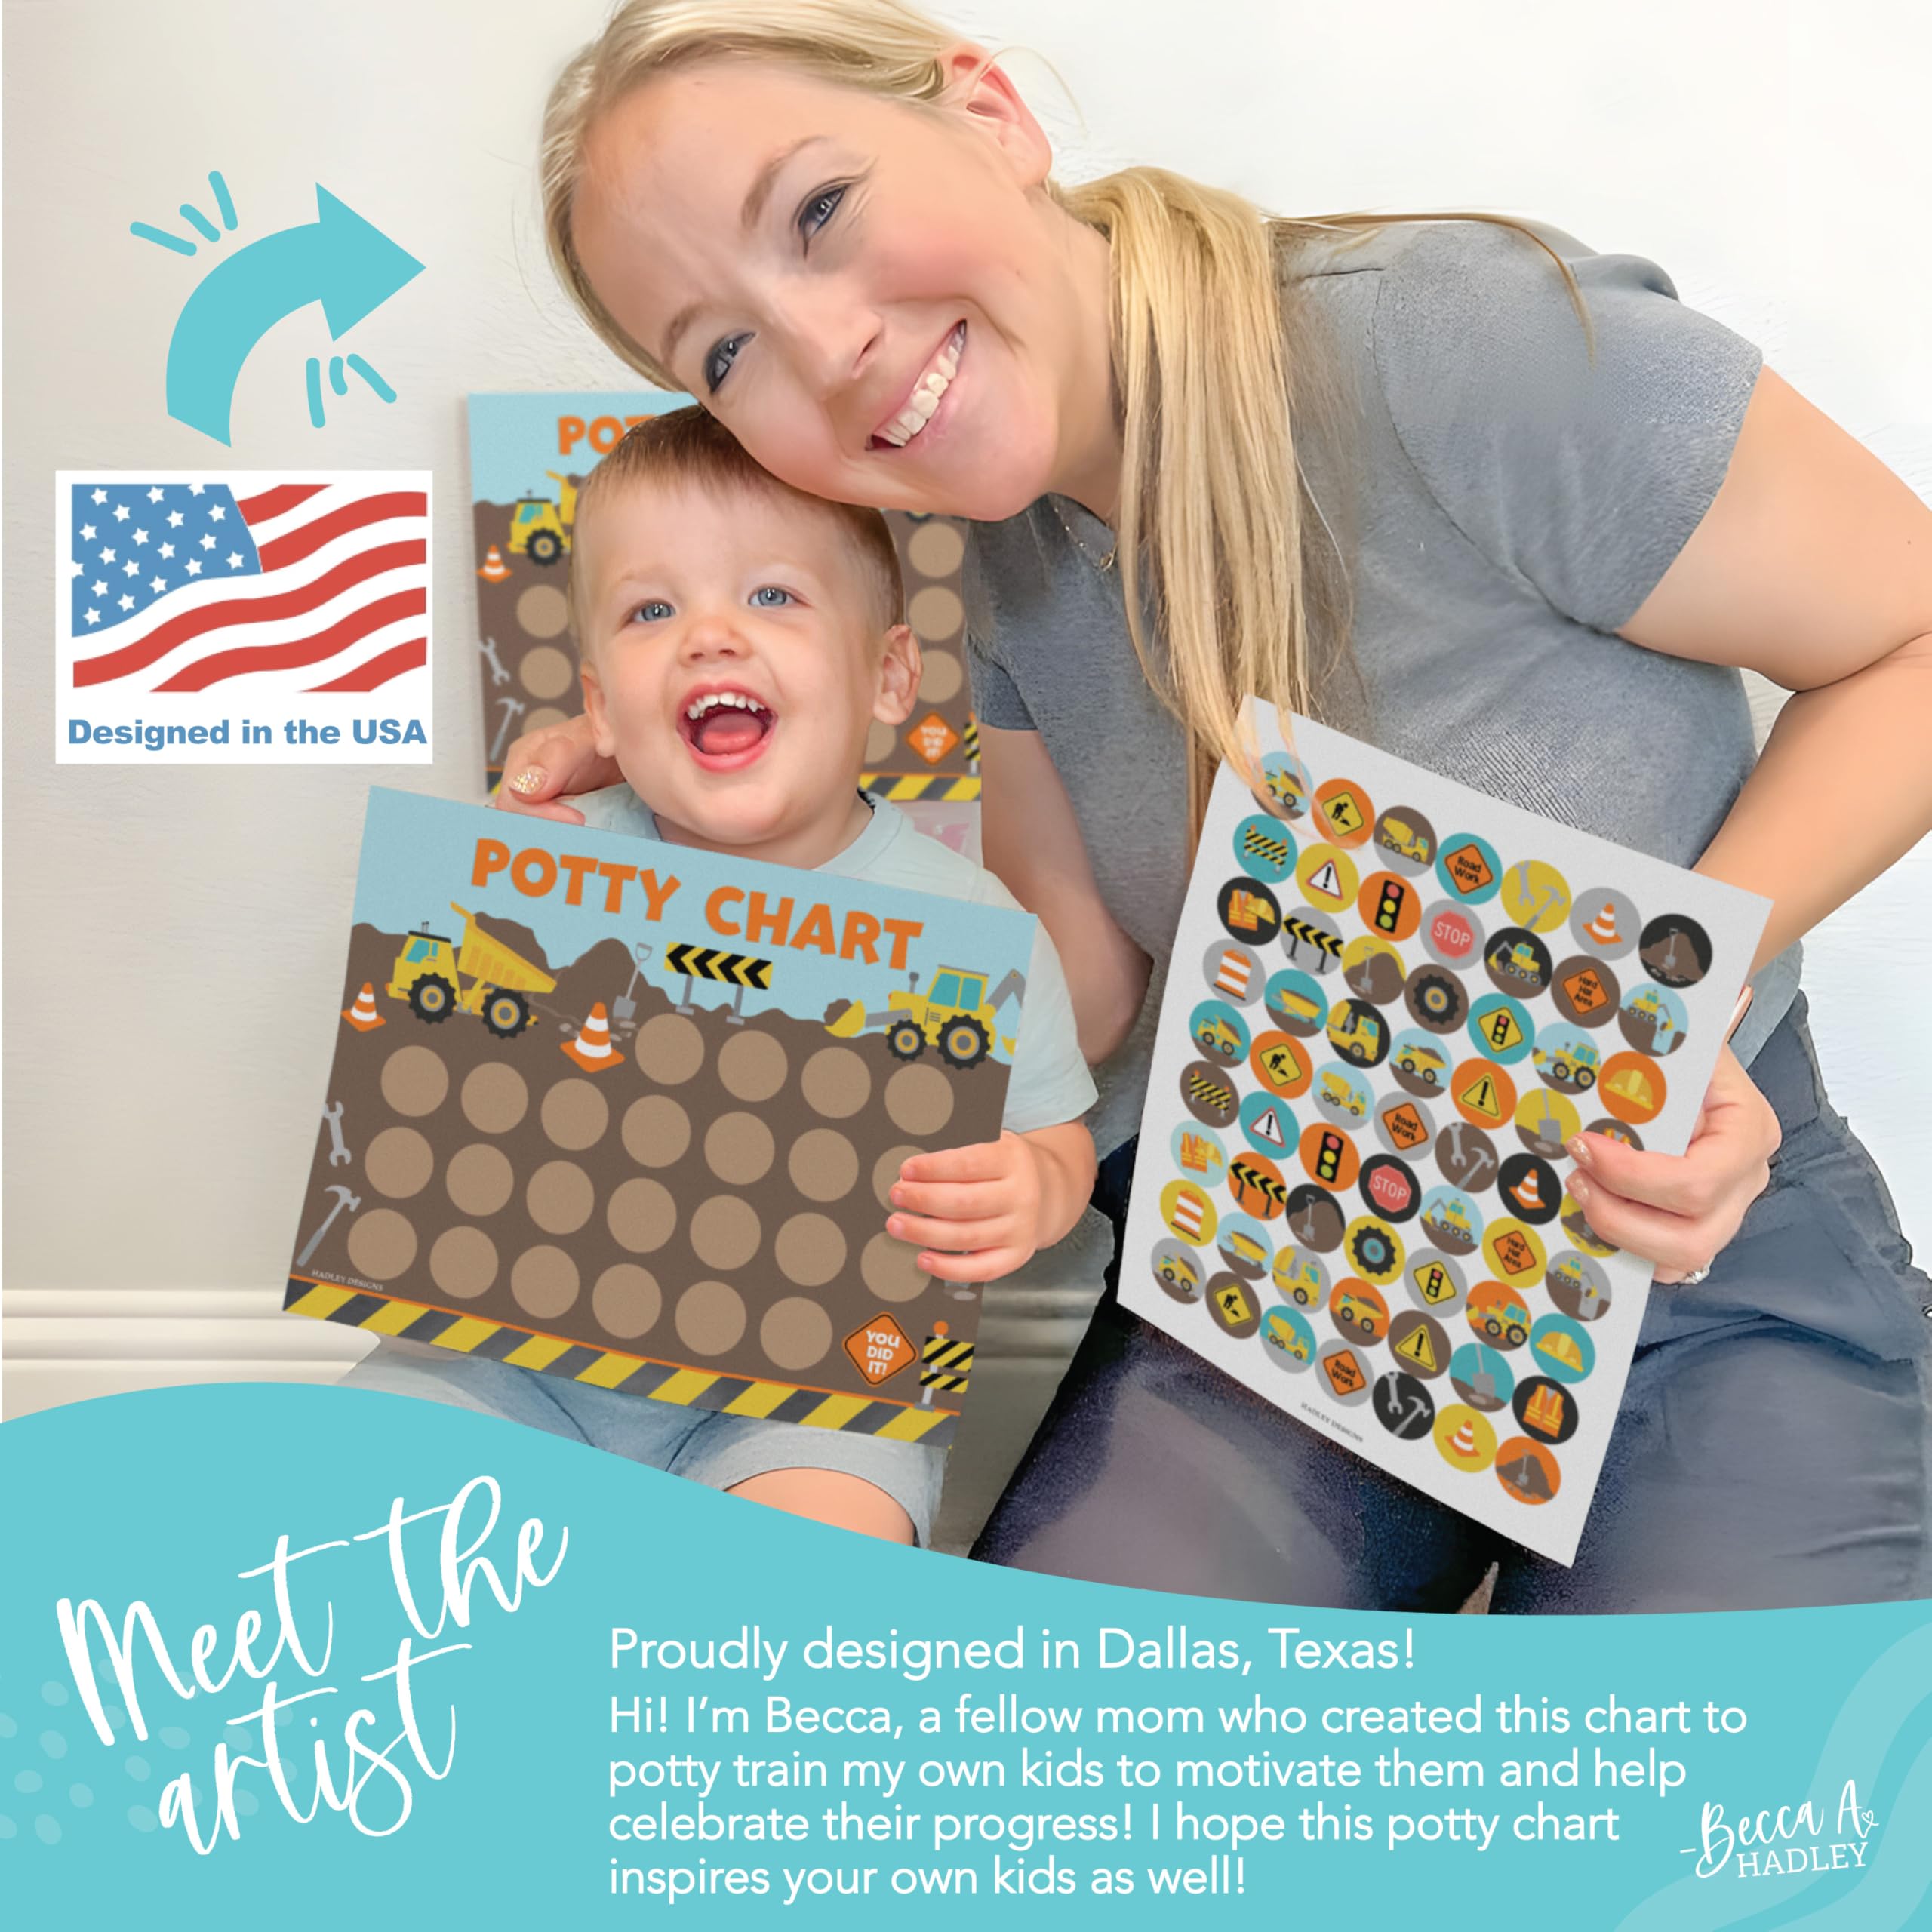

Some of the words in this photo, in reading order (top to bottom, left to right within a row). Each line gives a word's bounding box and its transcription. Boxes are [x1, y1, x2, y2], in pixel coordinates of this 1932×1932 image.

[1457, 855, 1481, 873] Road
[1454, 865, 1479, 884] Work
[471, 838, 681, 922] POTTY
[704, 885, 924, 971] CHART
[1434, 921, 1471, 946] STOP
[1392, 1121, 1415, 1141] Work
[1395, 1112, 1417, 1131] Road
[1373, 1175, 1407, 1201] STOP
[312, 1269, 346, 1284] HADLEY
[866, 1330, 900, 1349] YOU
[866, 1345, 894, 1361] DID
[867, 1361, 887, 1375] IT!
[1331, 1367, 1354, 1387] Work
[1335, 1359, 1355, 1377] Road
